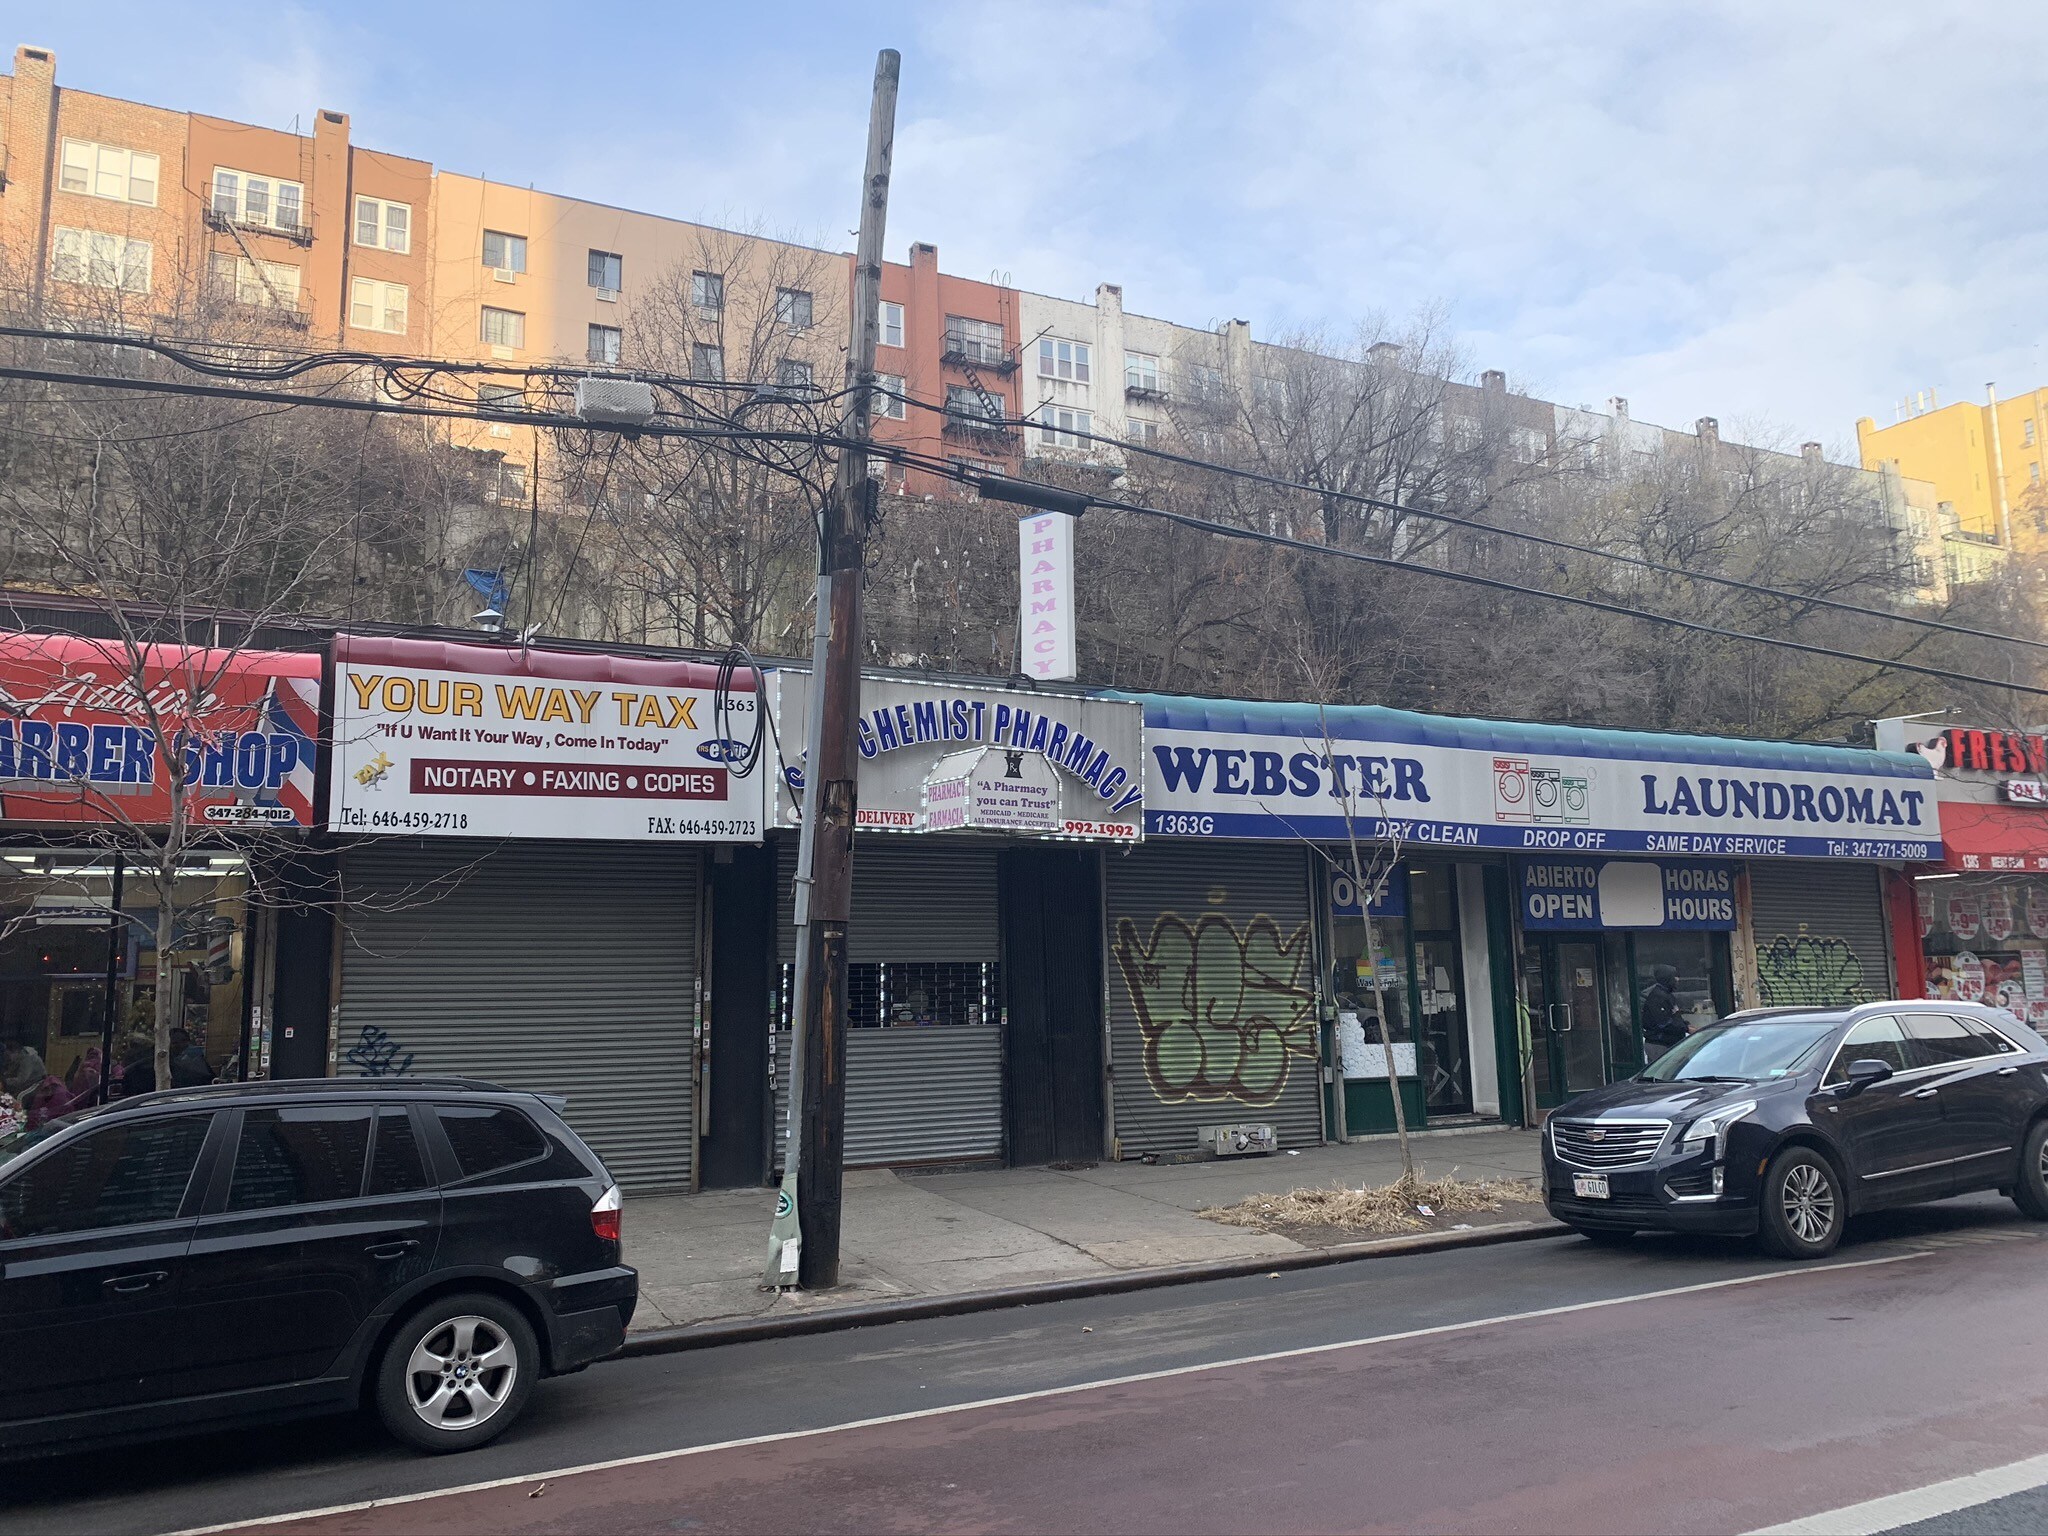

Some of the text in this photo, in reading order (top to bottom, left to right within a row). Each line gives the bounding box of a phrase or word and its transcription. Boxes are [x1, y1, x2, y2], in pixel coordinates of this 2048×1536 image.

[1030, 518, 1057, 674] PHARMACY
[348, 672, 698, 730] YOUR WAY TAX
[400, 724, 413, 739] U
[417, 725, 457, 741] Want
[459, 727, 471, 741] It
[474, 728, 509, 745] Your
[553, 733, 598, 750] Come
[600, 735, 615, 750] In
[617, 737, 669, 755] Today"
[1949, 728, 2045, 773] FRESH
[171, 730, 300, 790] SHOP
[352, 750, 395, 785] TAX
[858, 699, 1144, 814] CHEMIST PHARMACY
[423, 766, 715, 794] NOTARY FAXING COPIES
[928, 780, 966, 803] PHARMACY
[994, 781, 1049, 796] Pharmacy
[1152, 745, 1924, 827] WEBSTER LAUNDROMAT
[207, 806, 291, 820] 347-284-4012
[976, 797, 997, 809] you
[1000, 798, 1018, 807] can
[980, 808, 1049, 819] MEDICAID MEDICARE
[342, 807, 367, 826] Tel:
[648, 816, 676, 834] FAX:
[858, 809, 915, 827] DELIVERY
[928, 807, 964, 828] FARMACIA
[974, 816, 986, 824] ALL
[986, 817, 1022, 826] INSURANCE
[1154, 814, 1214, 834] 1363G
[1374, 820, 1479, 844] DRY CLEAN
[1522, 828, 1606, 850] DROP OFF
[1645, 834, 1787, 856] SAME DAY SERVICE
[1826, 840, 1928, 859] Tel: 347-271-5009
[1525, 865, 1596, 889] ABIERTO
[1665, 869, 1730, 892] HORAS
[1332, 877, 1389, 907] OFF
[1528, 894, 1594, 920] OPEN
[1667, 897, 1733, 921] HOURS
